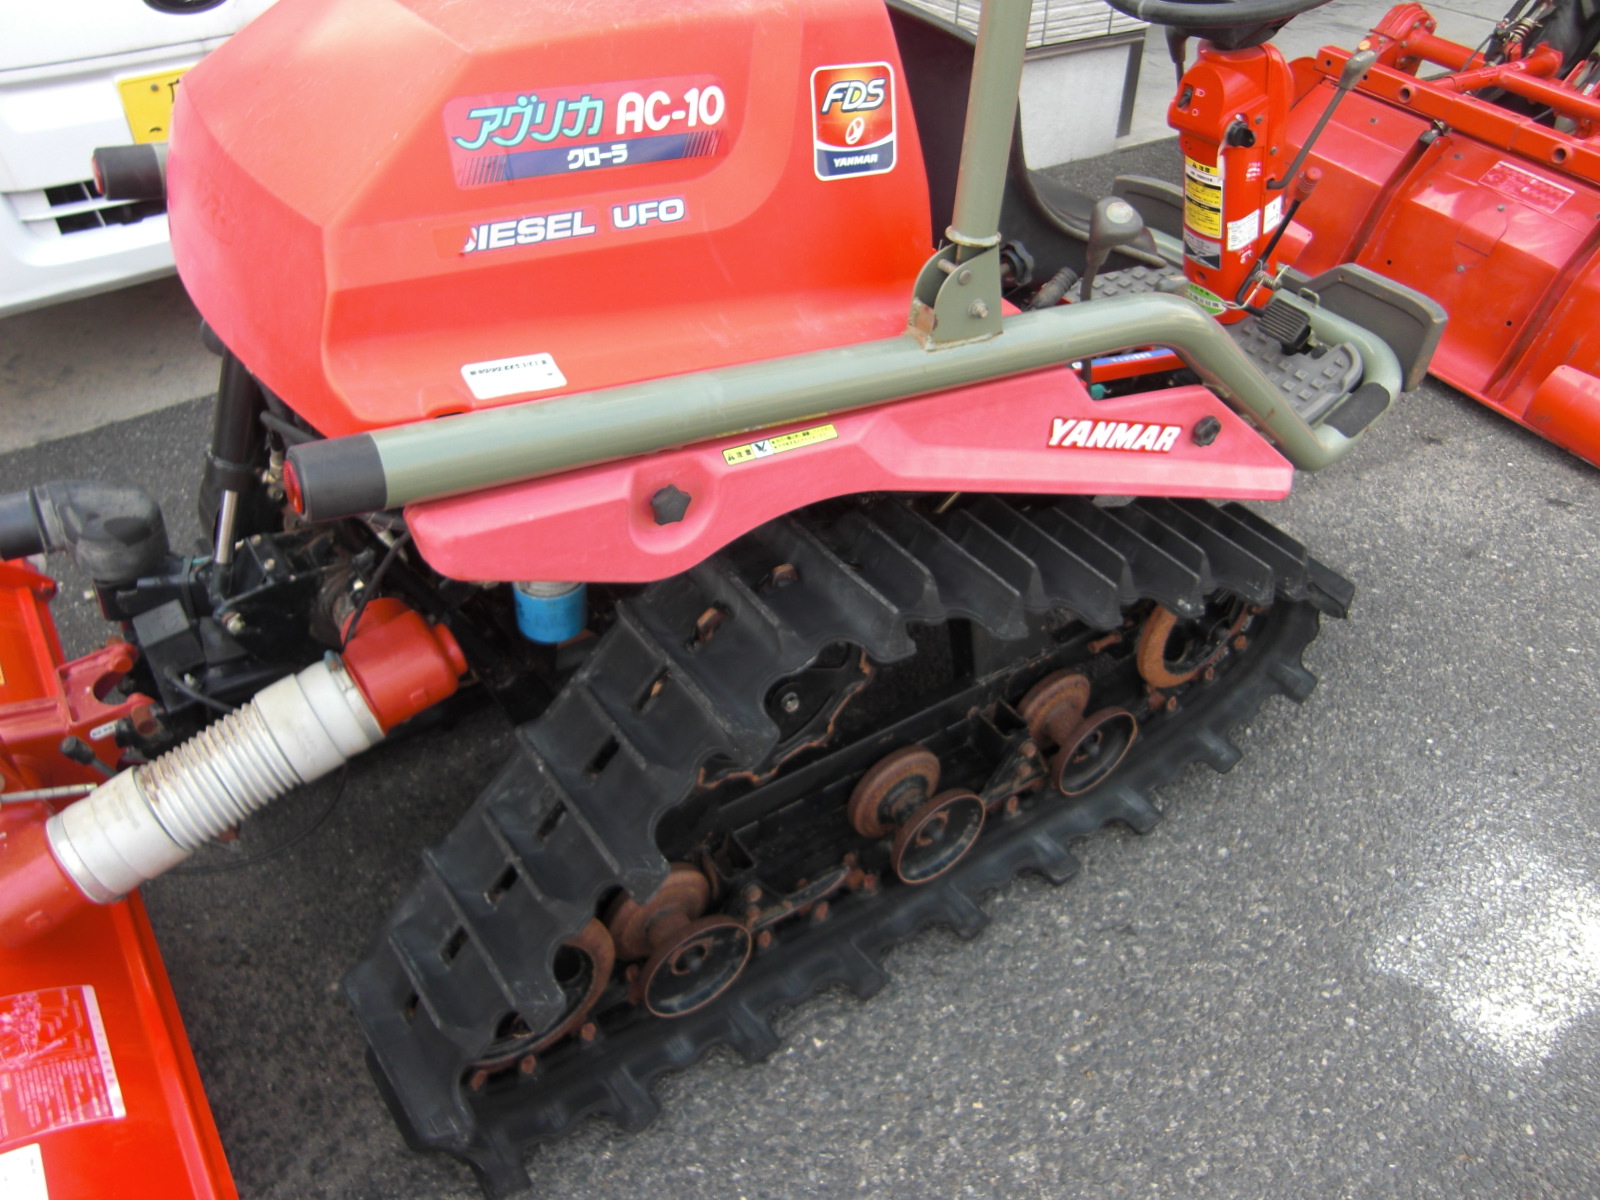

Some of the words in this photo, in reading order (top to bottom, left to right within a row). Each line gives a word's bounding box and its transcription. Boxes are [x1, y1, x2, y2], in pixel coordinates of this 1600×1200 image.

[821, 78, 886, 114] FDS
[453, 94, 604, 150] アグリカ
[616, 85, 725, 135] AC-10
[567, 143, 628, 169] クローラ
[833, 153, 878, 168] YANMAR
[612, 197, 685, 229] UFO
[1048, 418, 1181, 452] YANMAR
